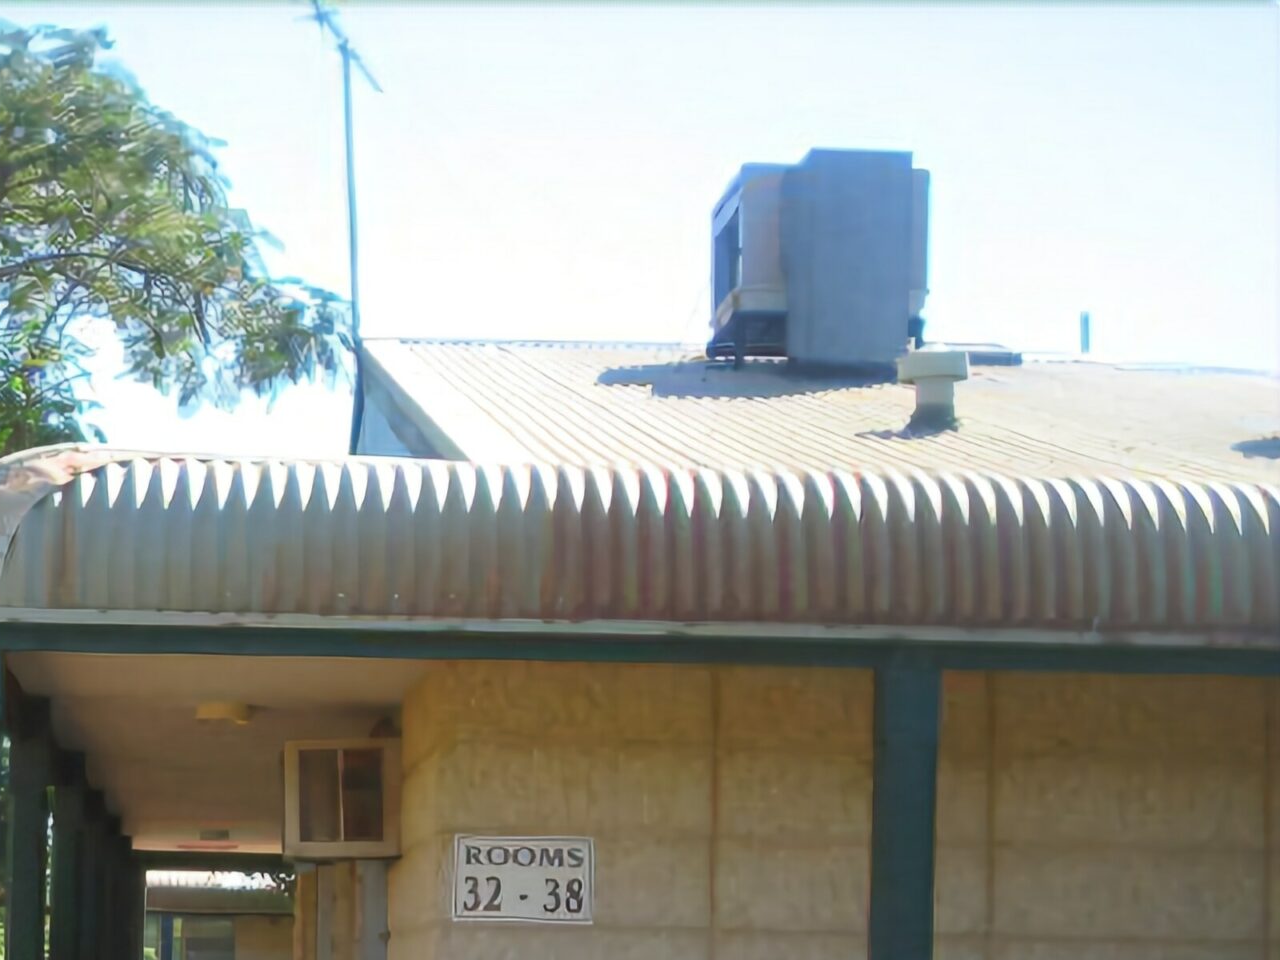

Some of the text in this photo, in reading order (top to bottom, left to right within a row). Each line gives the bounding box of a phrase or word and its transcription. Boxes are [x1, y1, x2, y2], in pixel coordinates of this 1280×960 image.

[465, 845, 584, 868] ROOMS
[463, 876, 502, 911] 32
[543, 878, 583, 913] 38
